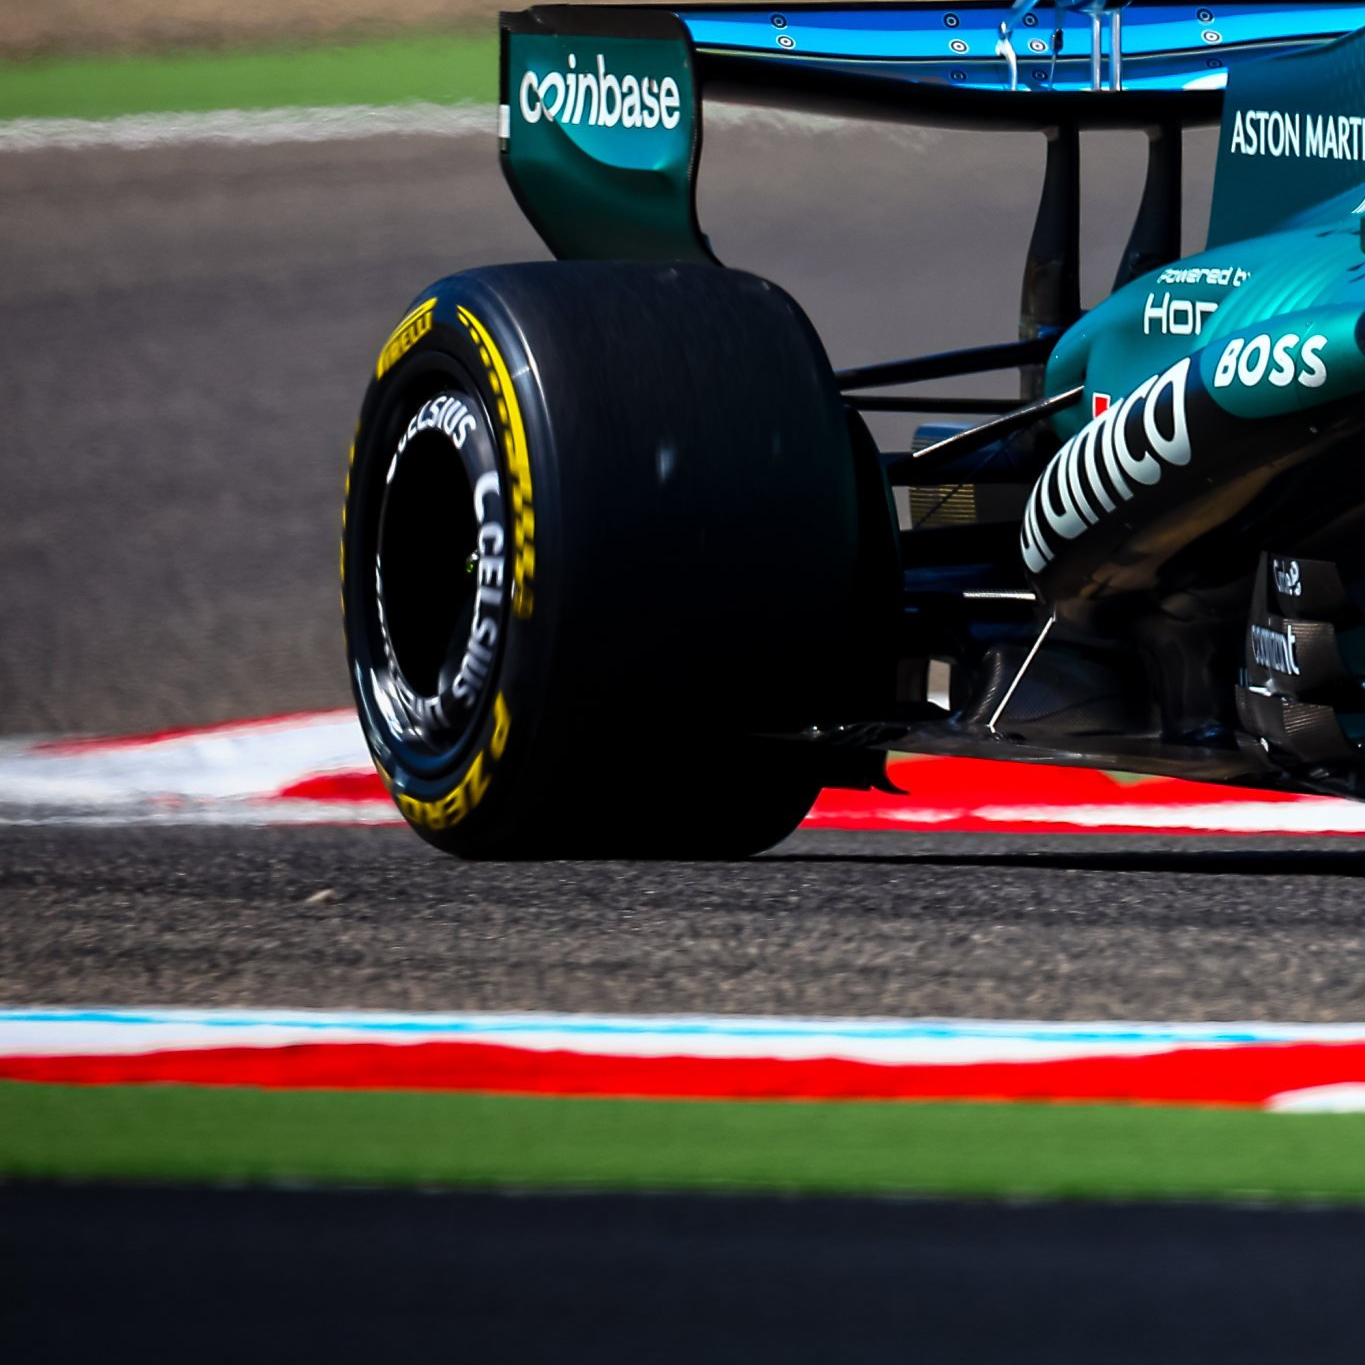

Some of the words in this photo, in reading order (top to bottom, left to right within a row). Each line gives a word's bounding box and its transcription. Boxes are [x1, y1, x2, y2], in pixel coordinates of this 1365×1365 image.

[519, 53, 681, 130] coinbase
[1231, 110, 1300, 157] ASTON
[1213, 334, 1328, 388] BOSS
